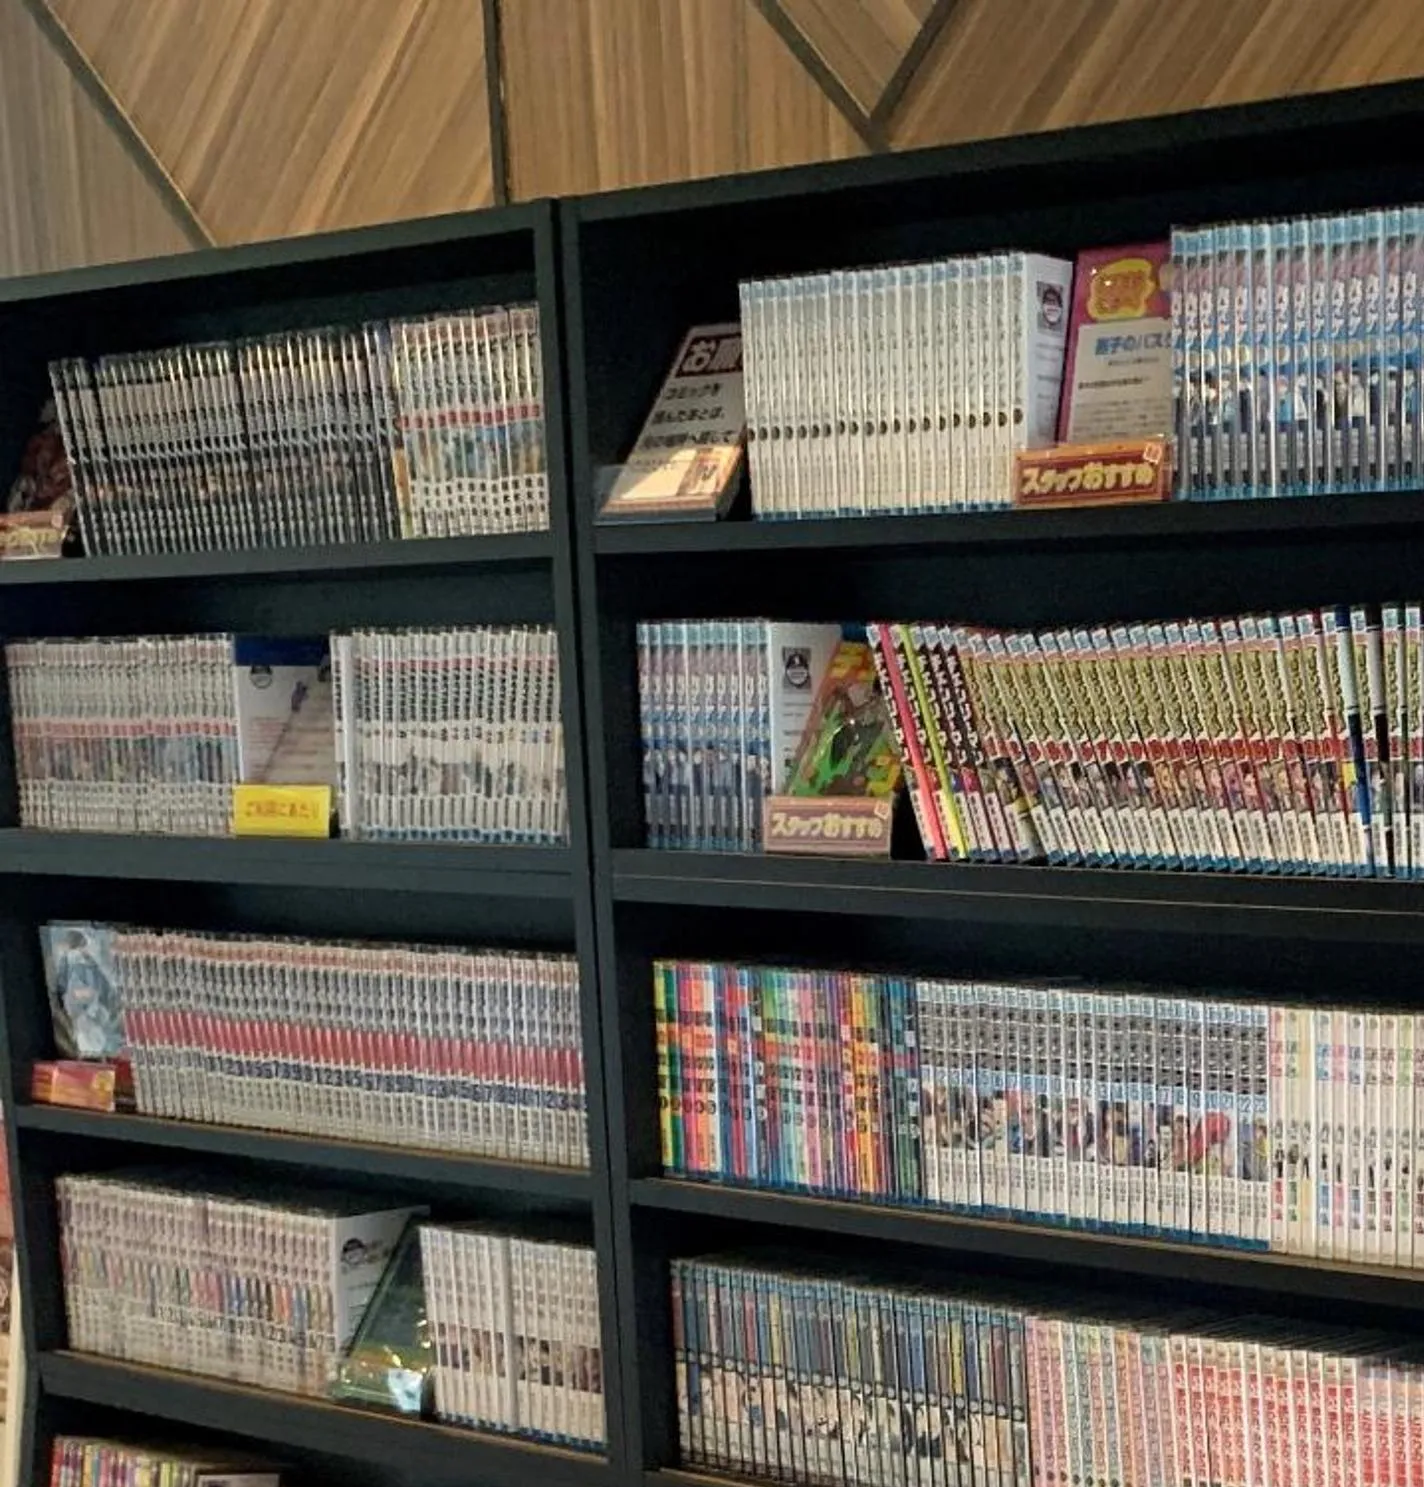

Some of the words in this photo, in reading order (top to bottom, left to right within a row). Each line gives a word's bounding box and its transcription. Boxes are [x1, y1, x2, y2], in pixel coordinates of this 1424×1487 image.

[1021, 462, 1153, 493] スタッフおすすめ
[771, 812, 883, 837] スタッフおすすめ
